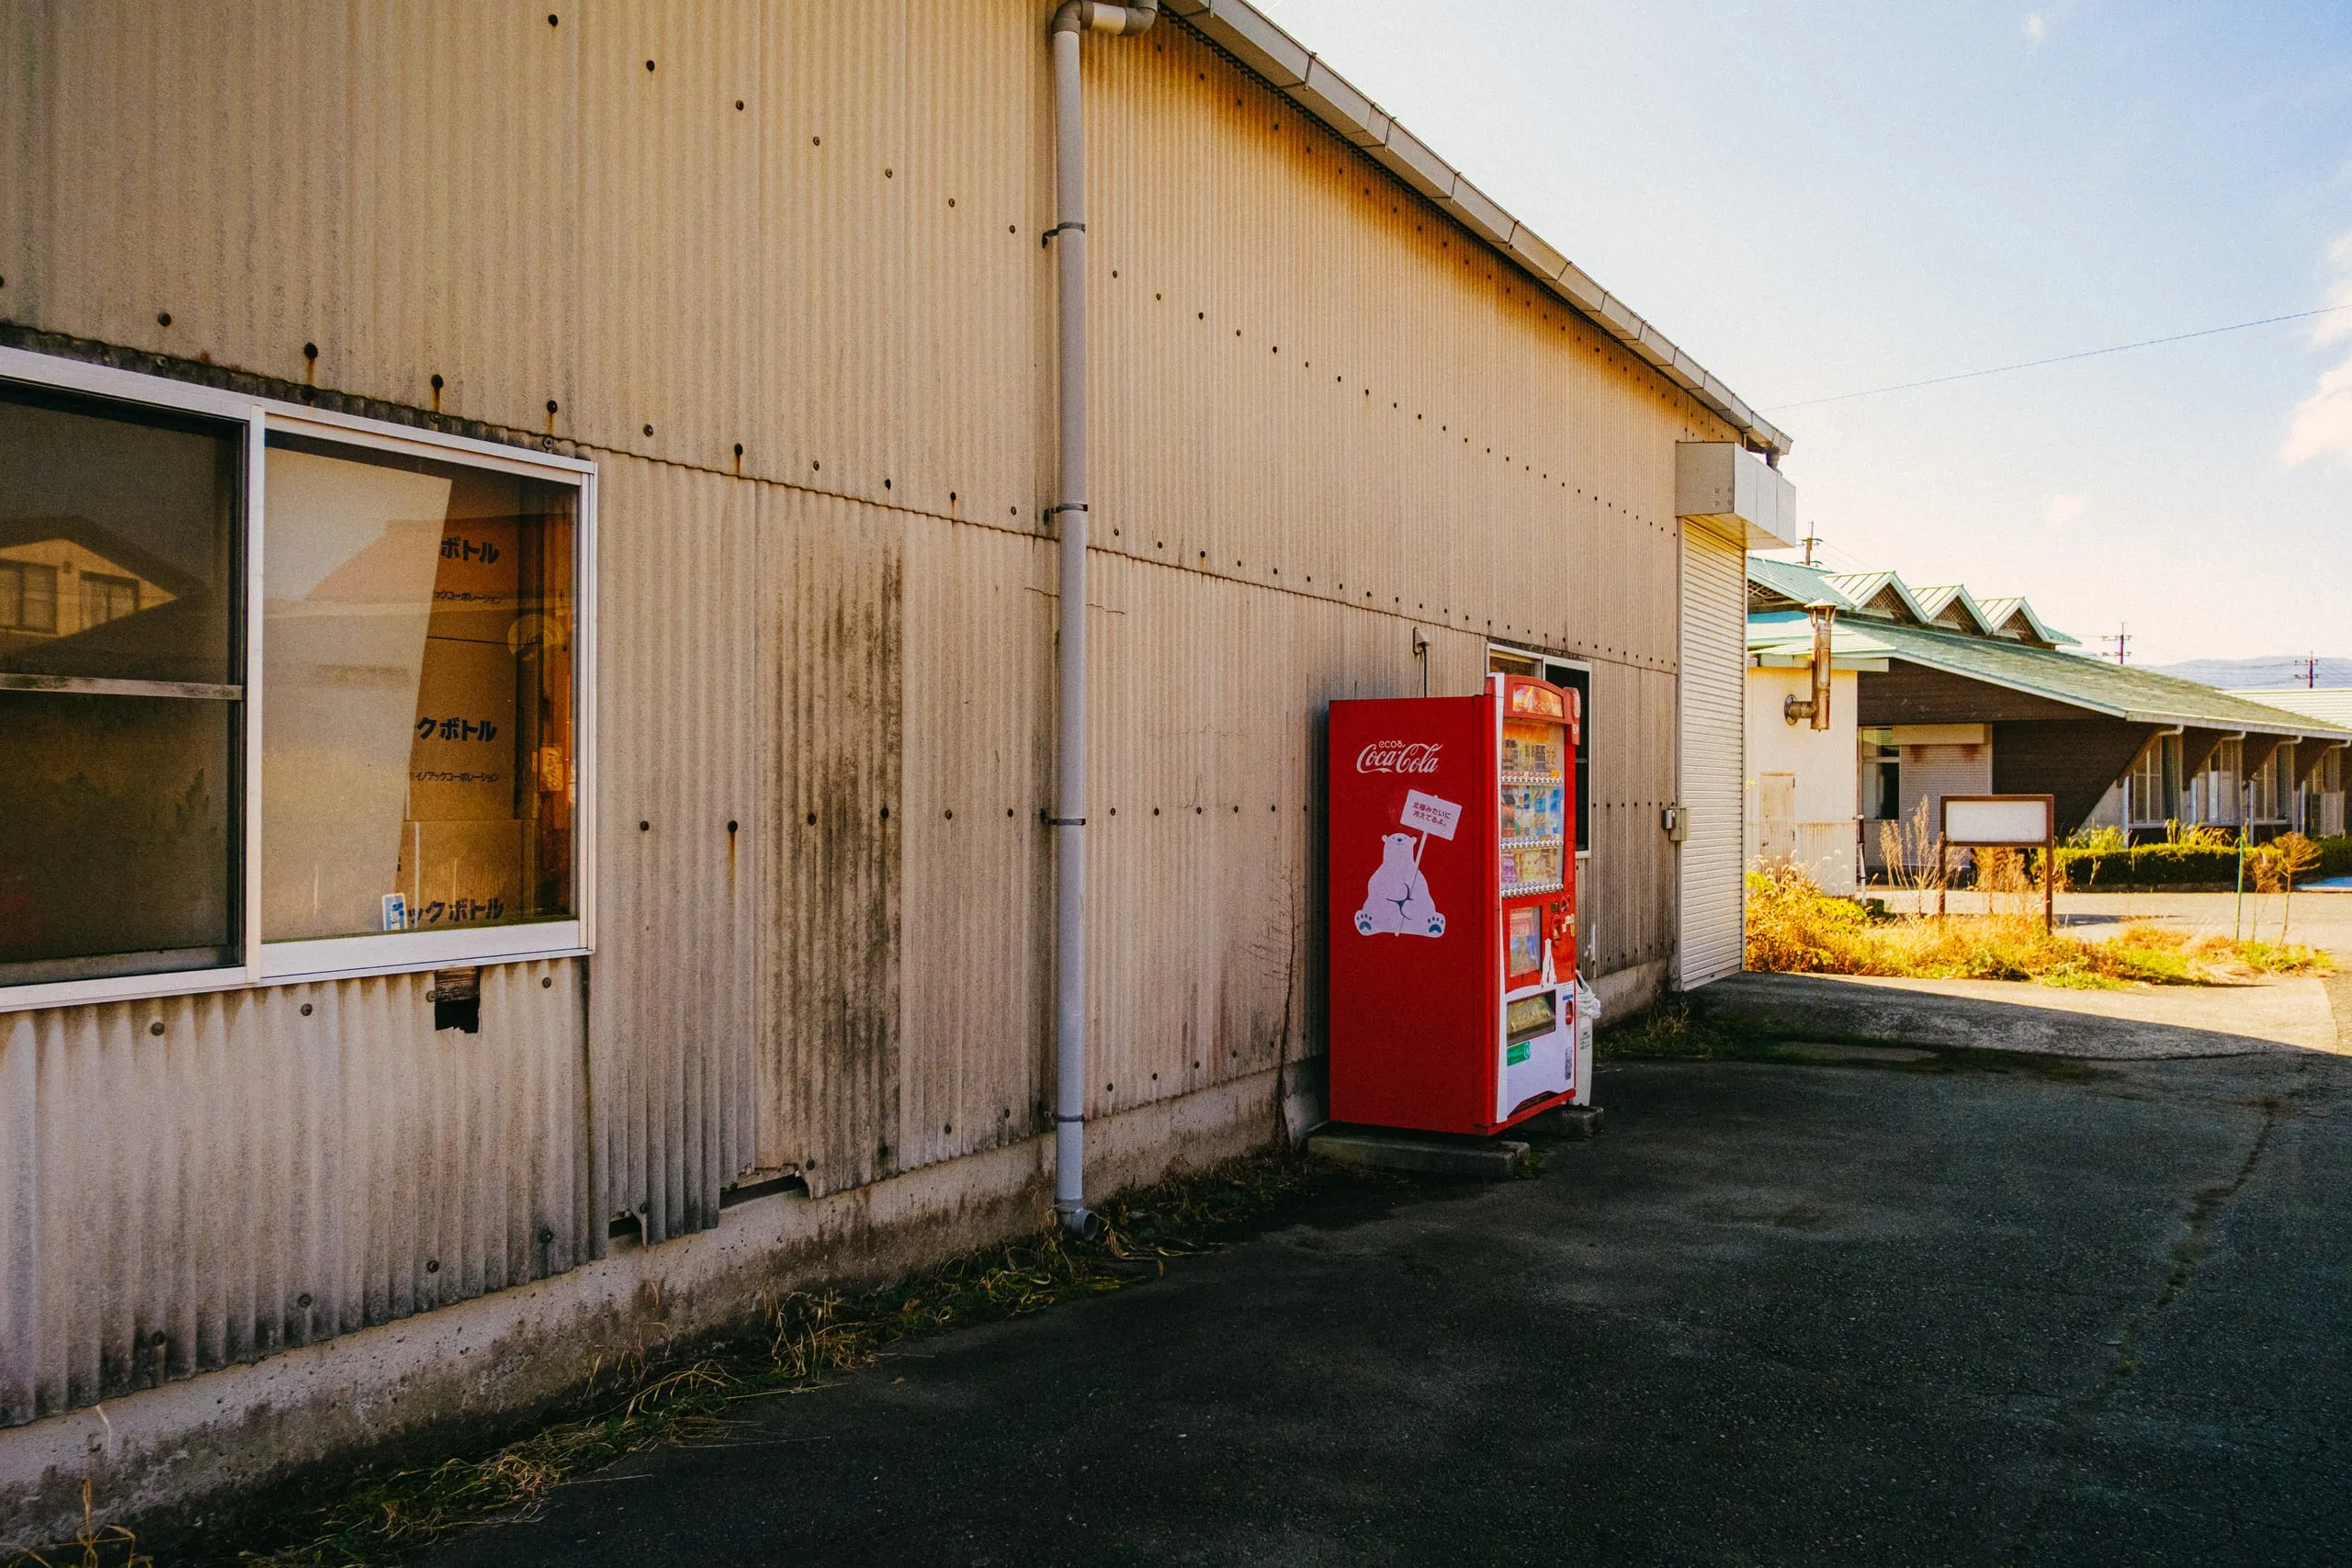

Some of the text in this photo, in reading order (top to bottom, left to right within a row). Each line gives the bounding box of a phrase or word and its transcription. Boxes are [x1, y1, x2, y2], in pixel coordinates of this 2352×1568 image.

[441, 536, 500, 564] ボトル
[416, 716, 498, 741] クボトル
[1356, 743, 1443, 773] Coca-Cola
[1413, 801, 1452, 819] 北極みたいに
